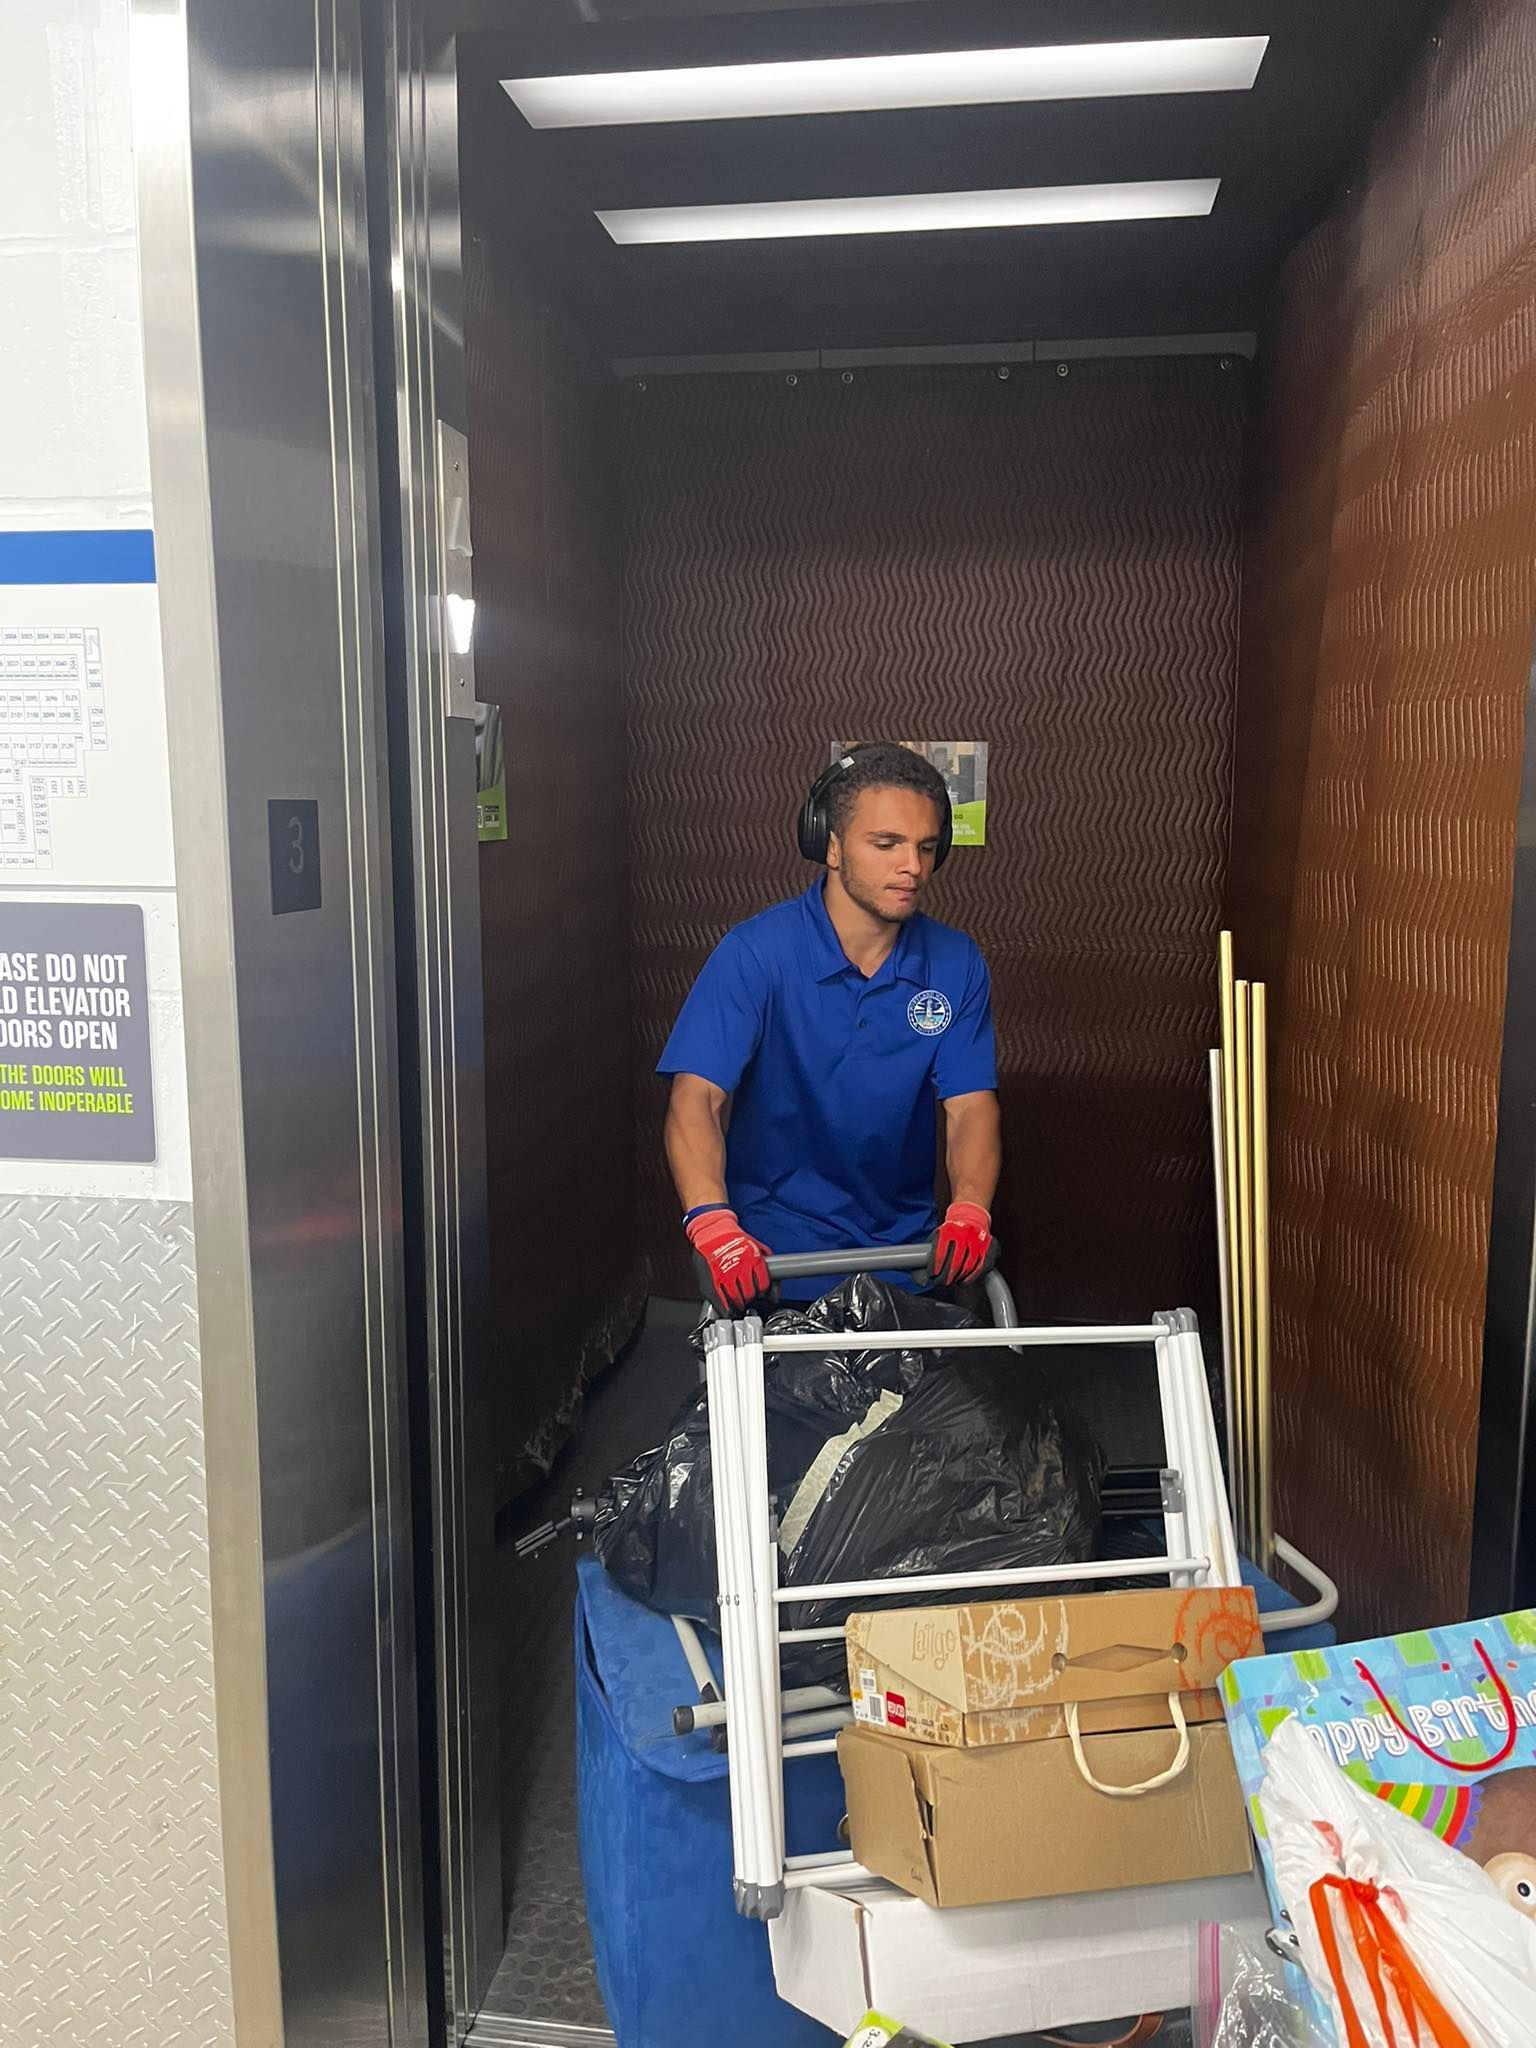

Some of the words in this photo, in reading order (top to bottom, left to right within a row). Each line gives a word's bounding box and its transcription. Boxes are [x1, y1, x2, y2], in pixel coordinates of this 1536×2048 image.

[288, 815, 304, 875] 3
[46, 953, 77, 983] DO
[84, 954, 128, 984] NOT
[25, 986, 131, 1017] ELEVATOR
[59, 1020, 118, 1050] OPEN
[0, 1064, 28, 1085] THE
[32, 1065, 85, 1088] DOORS
[89, 1066, 127, 1088] WILL
[39, 1090, 134, 1114] INOPERABLE
